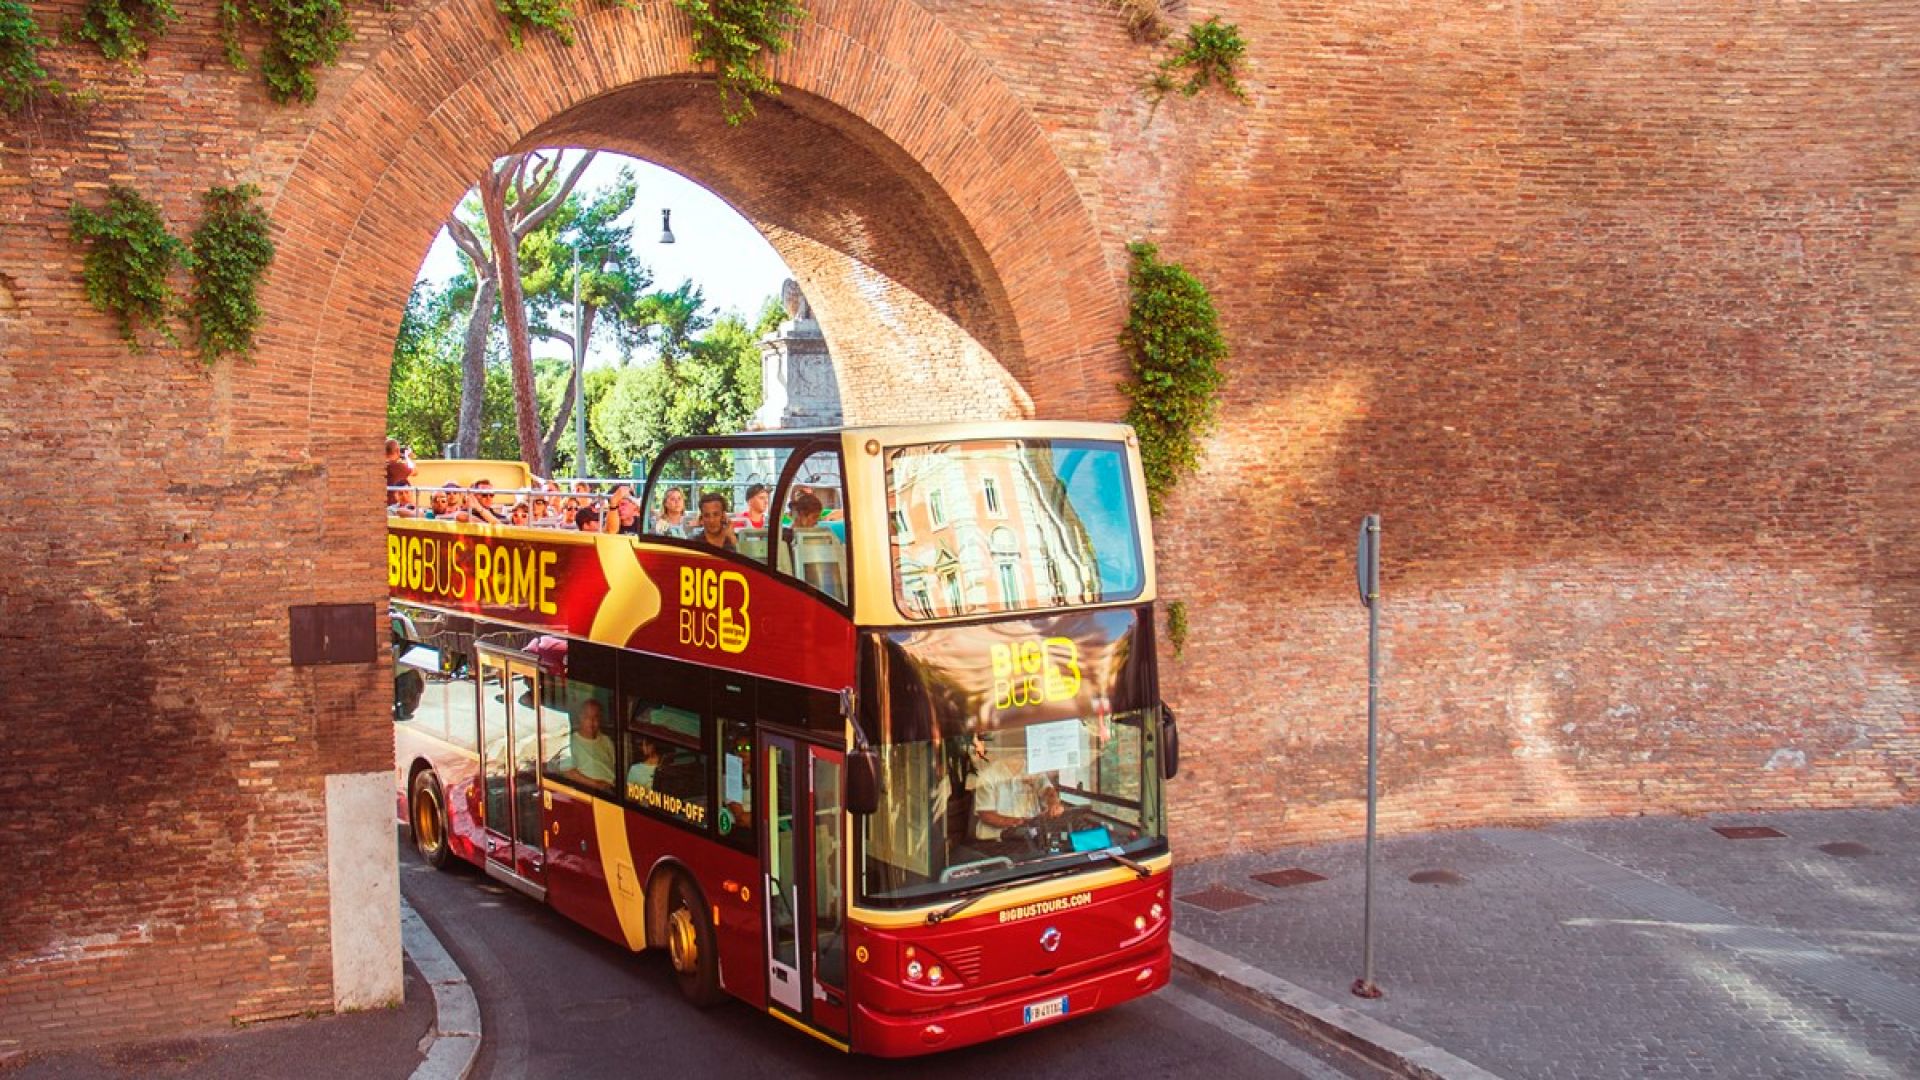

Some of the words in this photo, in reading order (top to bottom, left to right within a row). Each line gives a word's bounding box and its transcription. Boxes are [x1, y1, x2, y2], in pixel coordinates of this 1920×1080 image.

[475, 543, 558, 615] ROME
[680, 566, 718, 610] BIG
[679, 608, 718, 649] BUS
[990, 640, 1041, 678] BIG
[995, 674, 1044, 709] BUS
[628, 783, 662, 808] HOP-ON
[663, 794, 705, 823] HOP-OFF
[999, 892, 1092, 924] BIGBUSTOURS.COM
